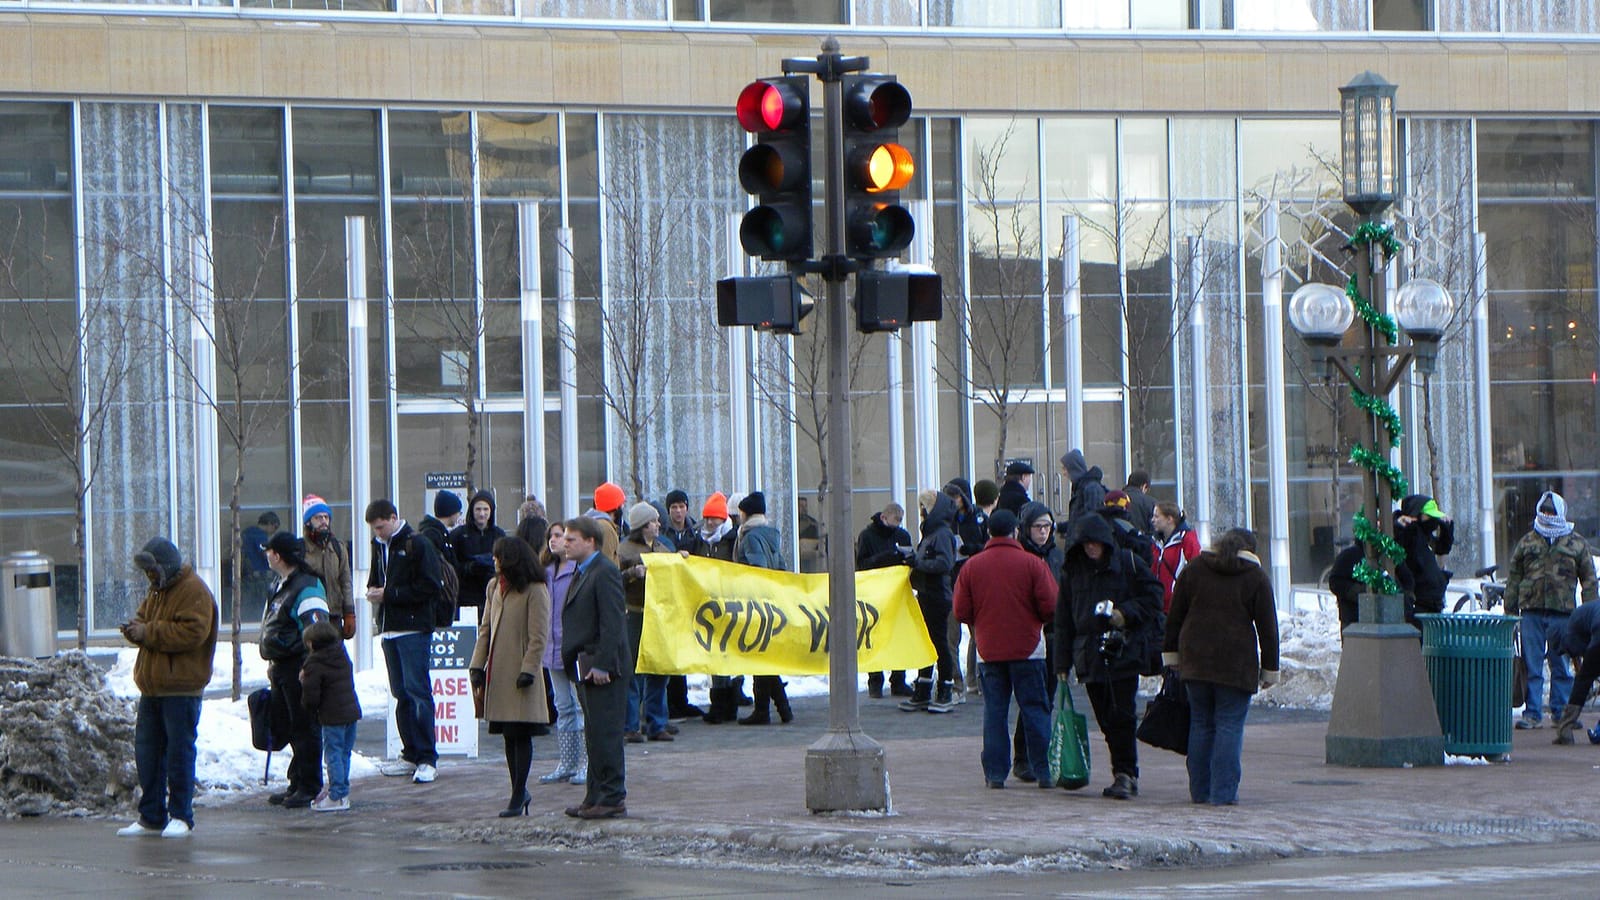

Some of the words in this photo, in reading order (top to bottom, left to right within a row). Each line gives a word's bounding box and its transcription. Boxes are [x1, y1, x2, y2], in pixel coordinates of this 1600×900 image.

[694, 600, 788, 653] STOP
[798, 600, 879, 653] WR
[432, 631, 460, 641] NN
[431, 643, 455, 655] OS
[430, 657, 465, 667] FEE
[432, 678, 468, 695] ASE
[434, 702, 457, 719] ME
[434, 725, 459, 743] IN!
